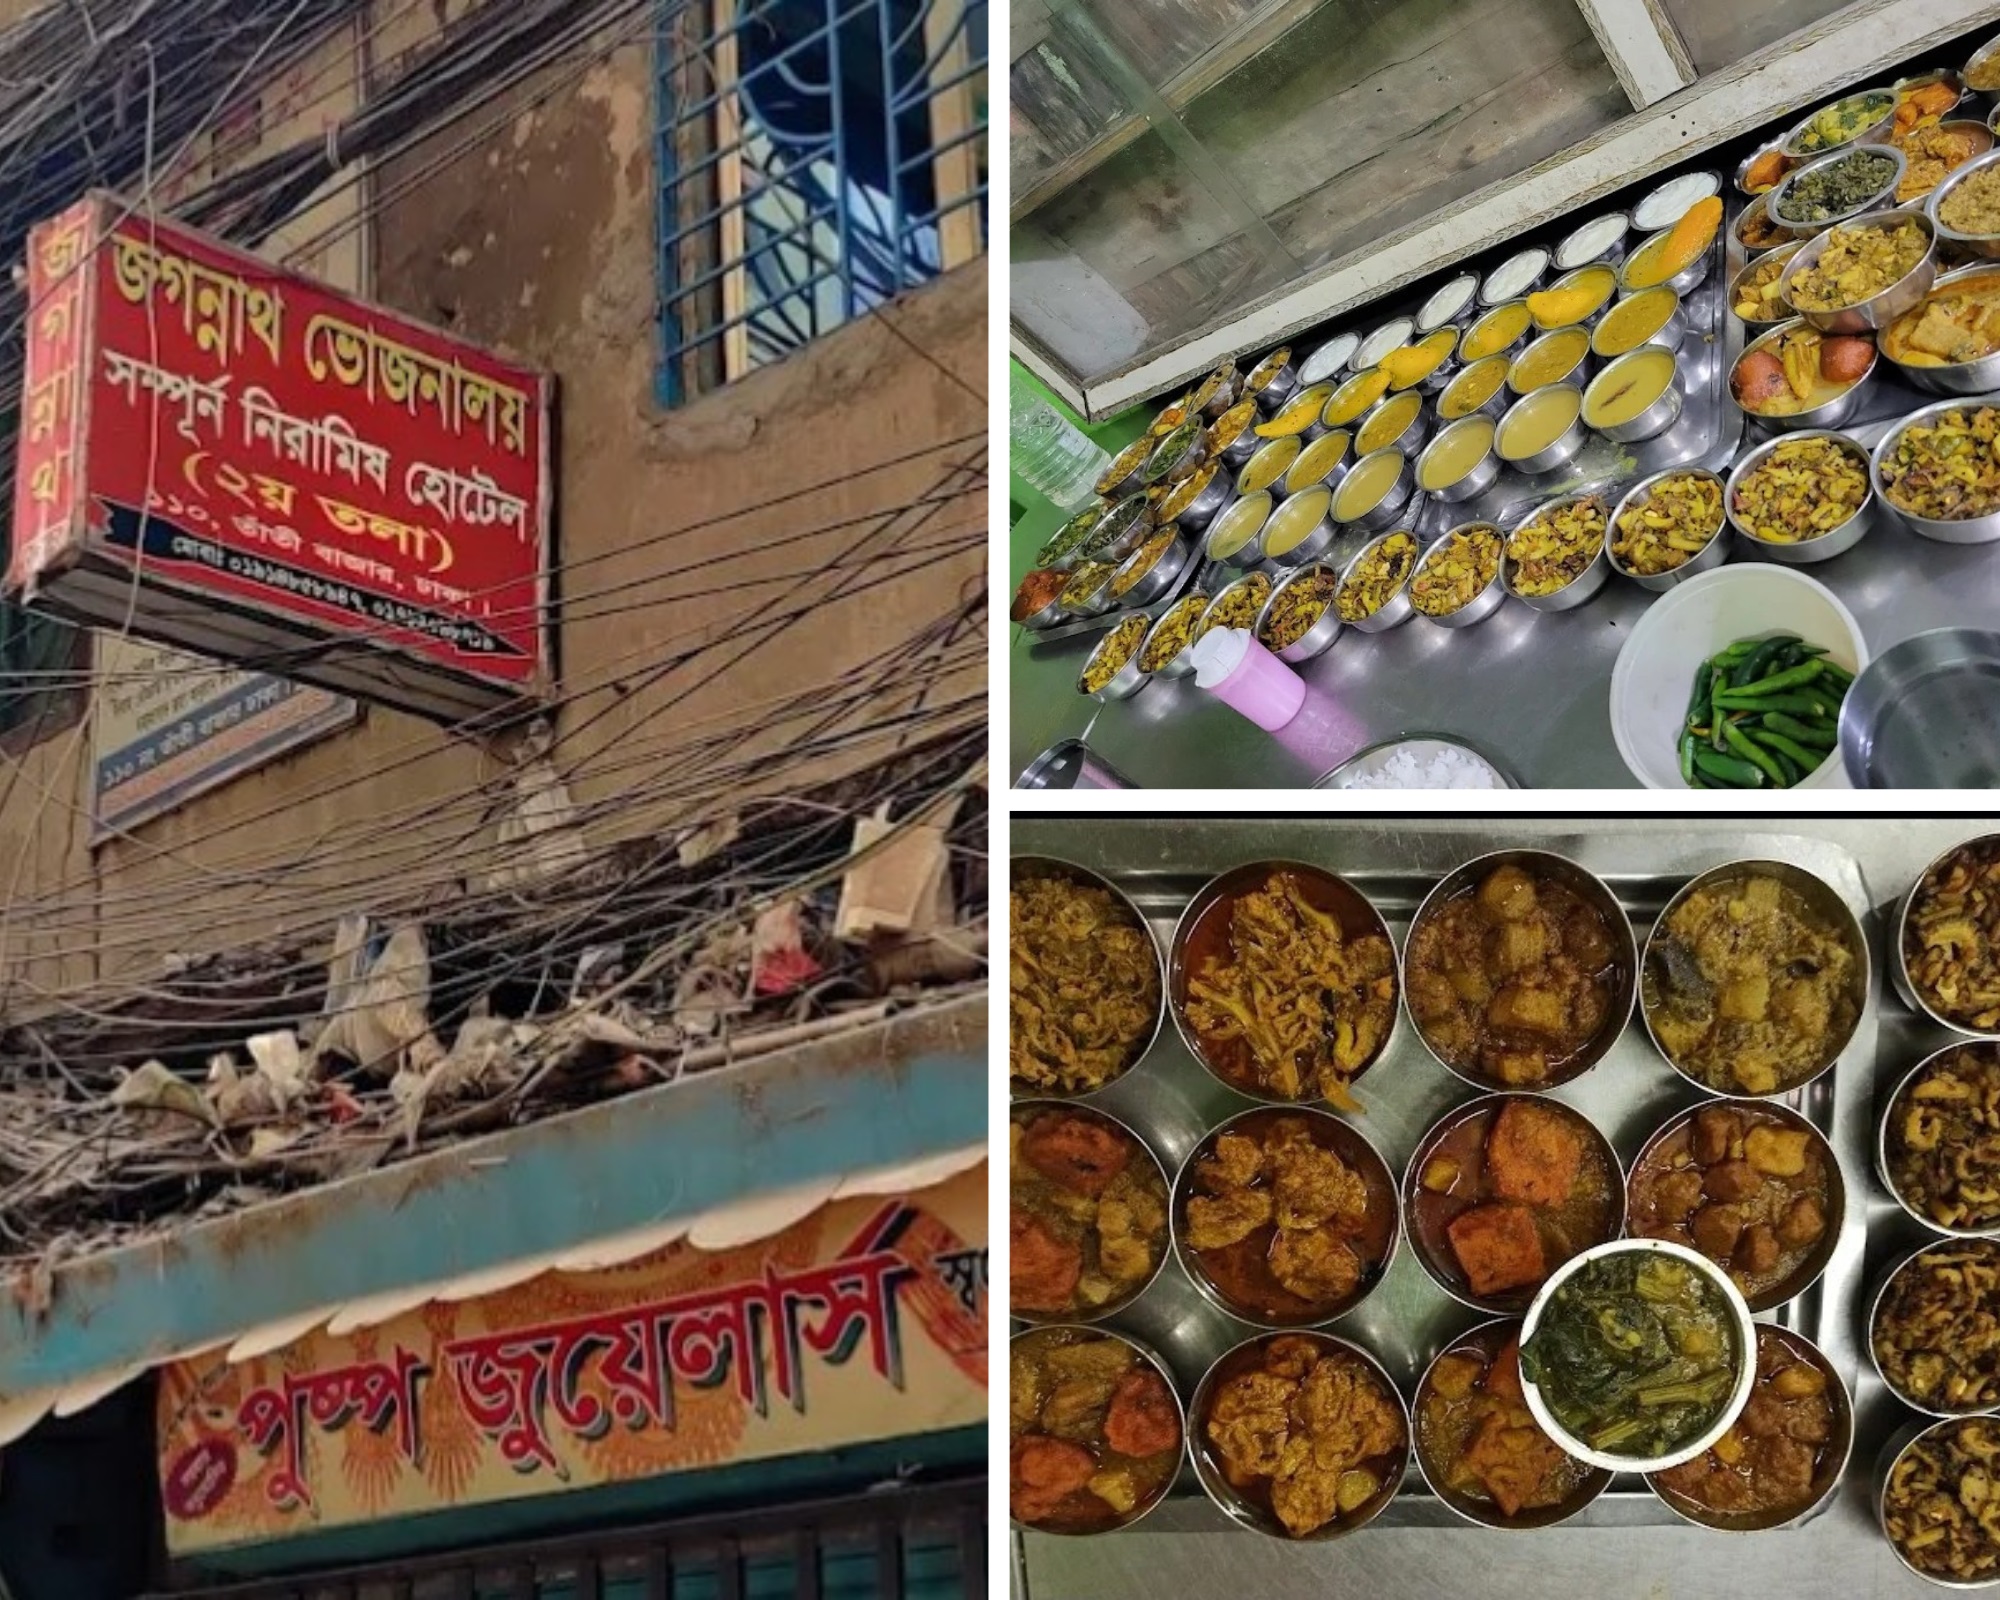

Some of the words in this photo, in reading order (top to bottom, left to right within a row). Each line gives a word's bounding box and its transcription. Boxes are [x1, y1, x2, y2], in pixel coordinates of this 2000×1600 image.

[111, 234, 285, 366] জগন্নাথ
[304, 314, 529, 457] ভোজনালয়
[183, 452, 298, 516] (২য়
[312, 494, 453, 573] তলা)
[238, 386, 391, 496] নিরামিষ
[405, 462, 528, 543] হোটেল
[239, 1345, 432, 1519] পুষ্প
[443, 1200, 914, 1480] জুয়েলার্স
